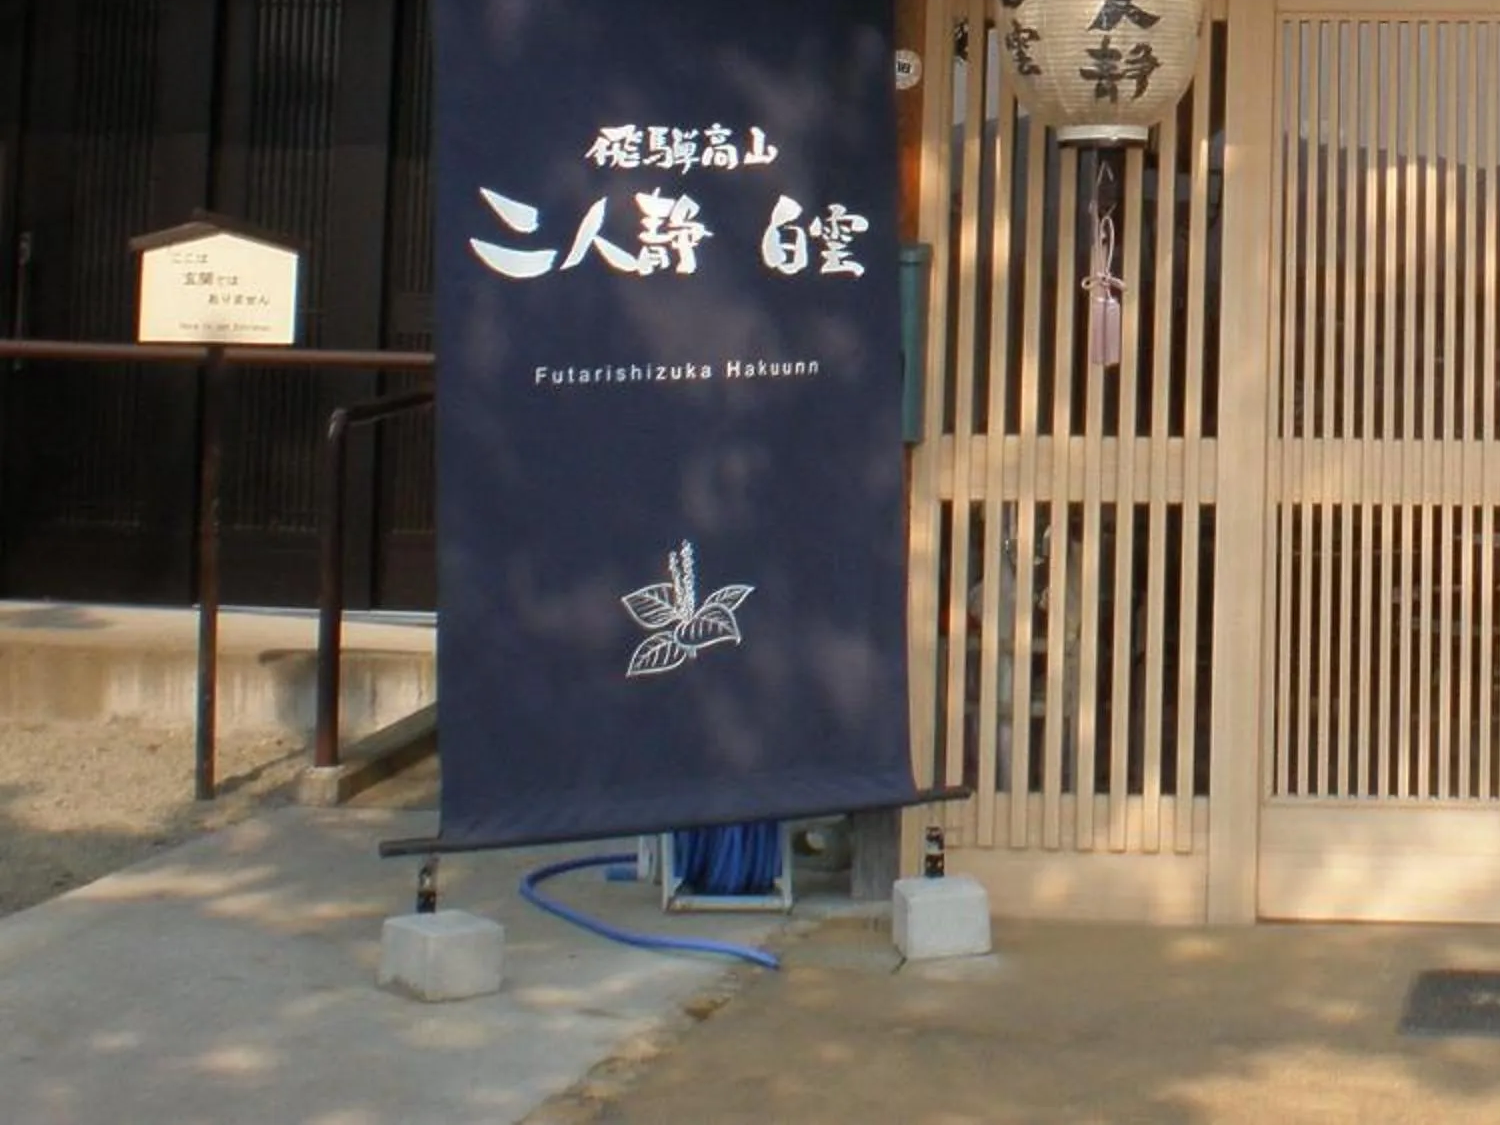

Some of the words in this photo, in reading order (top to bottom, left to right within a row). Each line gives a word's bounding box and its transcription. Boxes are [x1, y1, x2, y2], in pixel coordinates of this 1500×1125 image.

[584, 122, 779, 174] 飛騨高山
[470, 187, 713, 278] 二人静
[761, 195, 869, 277] 白雲
[535, 362, 712, 386] Futarishizuka
[726, 359, 820, 379] Hakuunn
